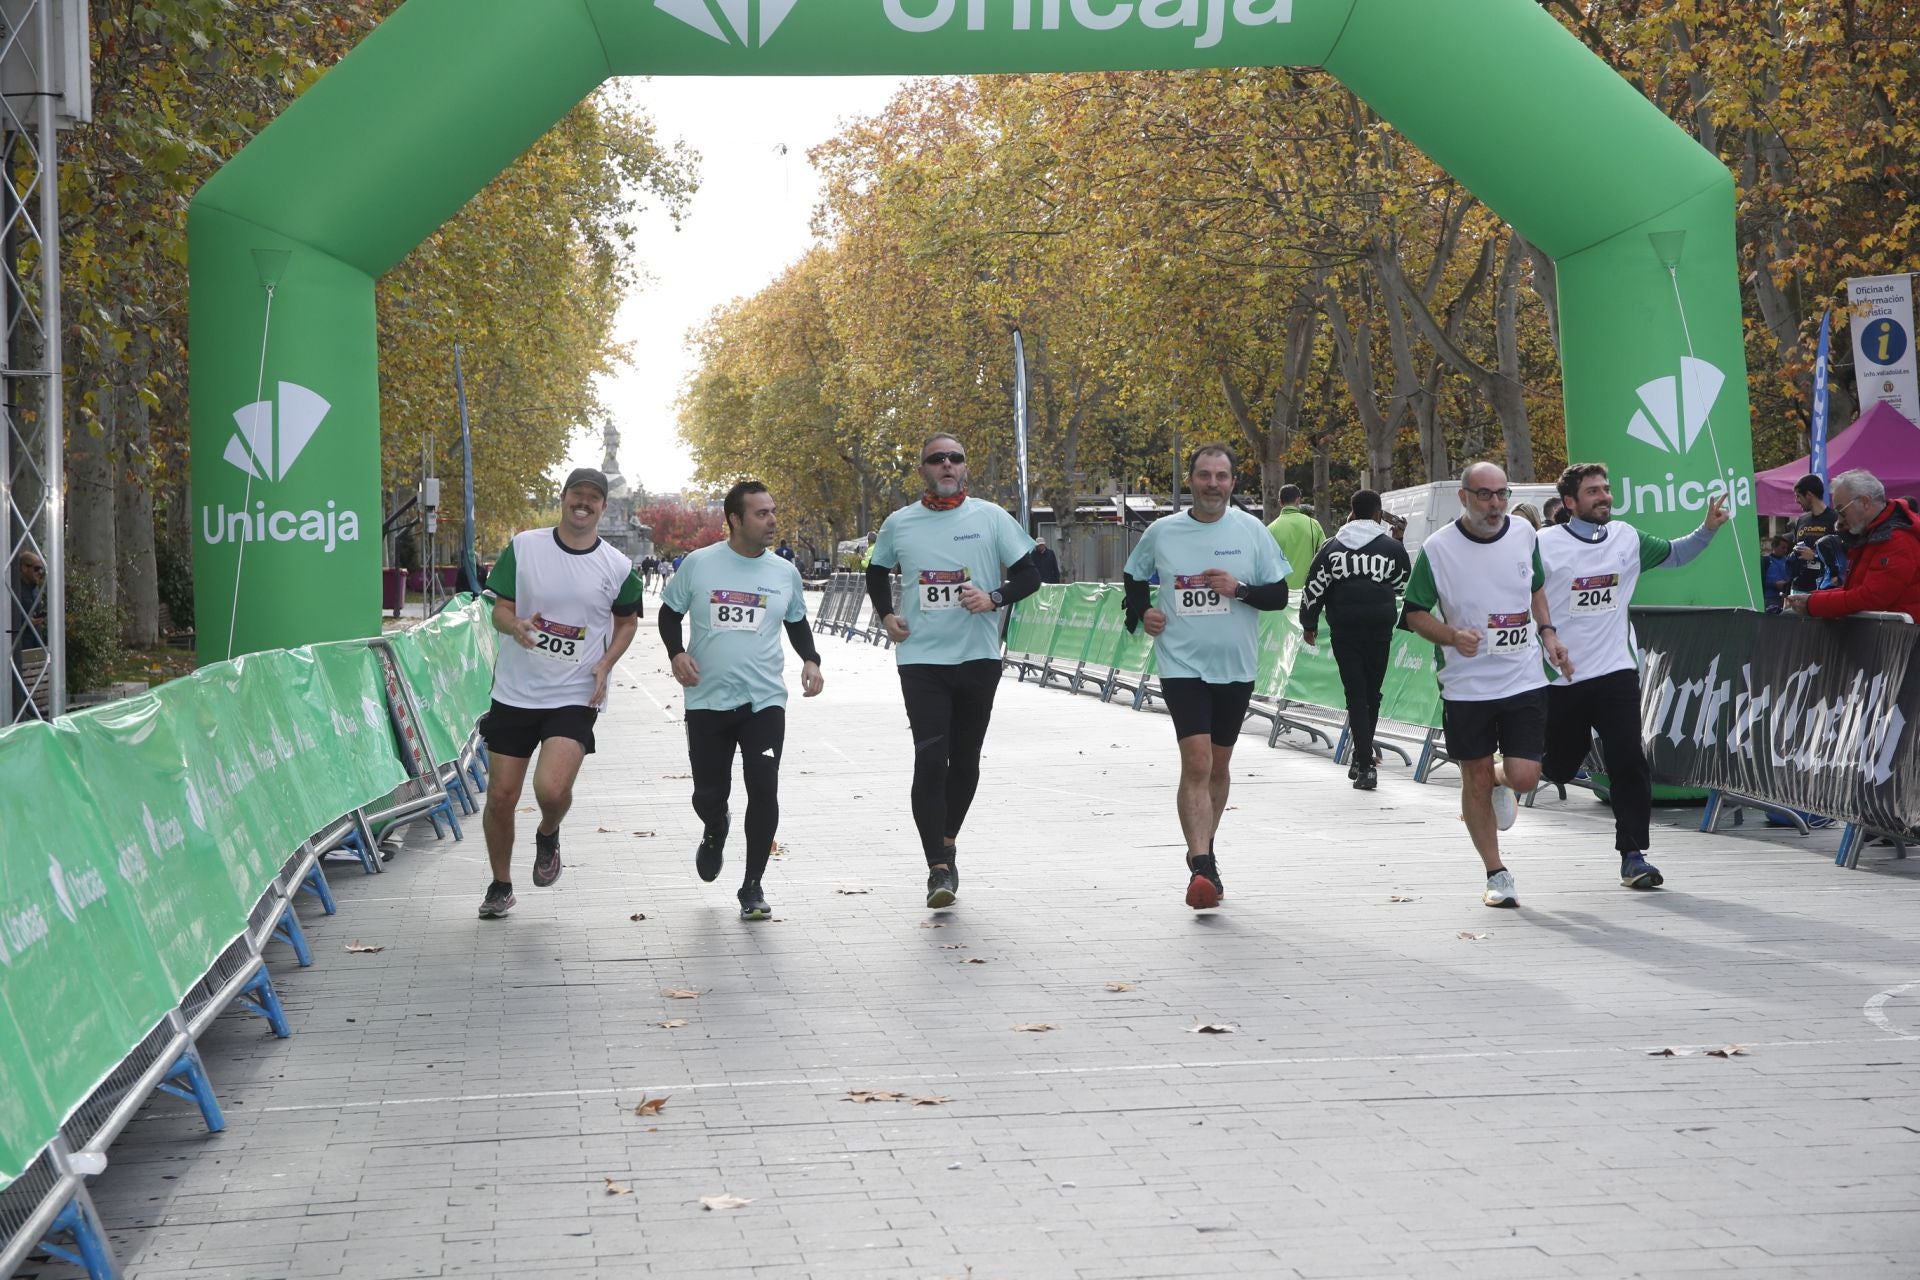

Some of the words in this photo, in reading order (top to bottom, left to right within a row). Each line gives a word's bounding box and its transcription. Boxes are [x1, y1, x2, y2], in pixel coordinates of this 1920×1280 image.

[1856, 286, 1883, 294] Oficina
[1885, 284, 1894, 292] de
[1610, 467, 1751, 520] Unicaja
[203, 500, 359, 552] Unicaja
[1302, 564, 1332, 610] Los
[1577, 588, 1612, 606] 204
[1182, 590, 1220, 607] 809
[718, 605, 755, 623] 831
[535, 633, 576, 656] 203
[1495, 627, 1528, 647] 202
